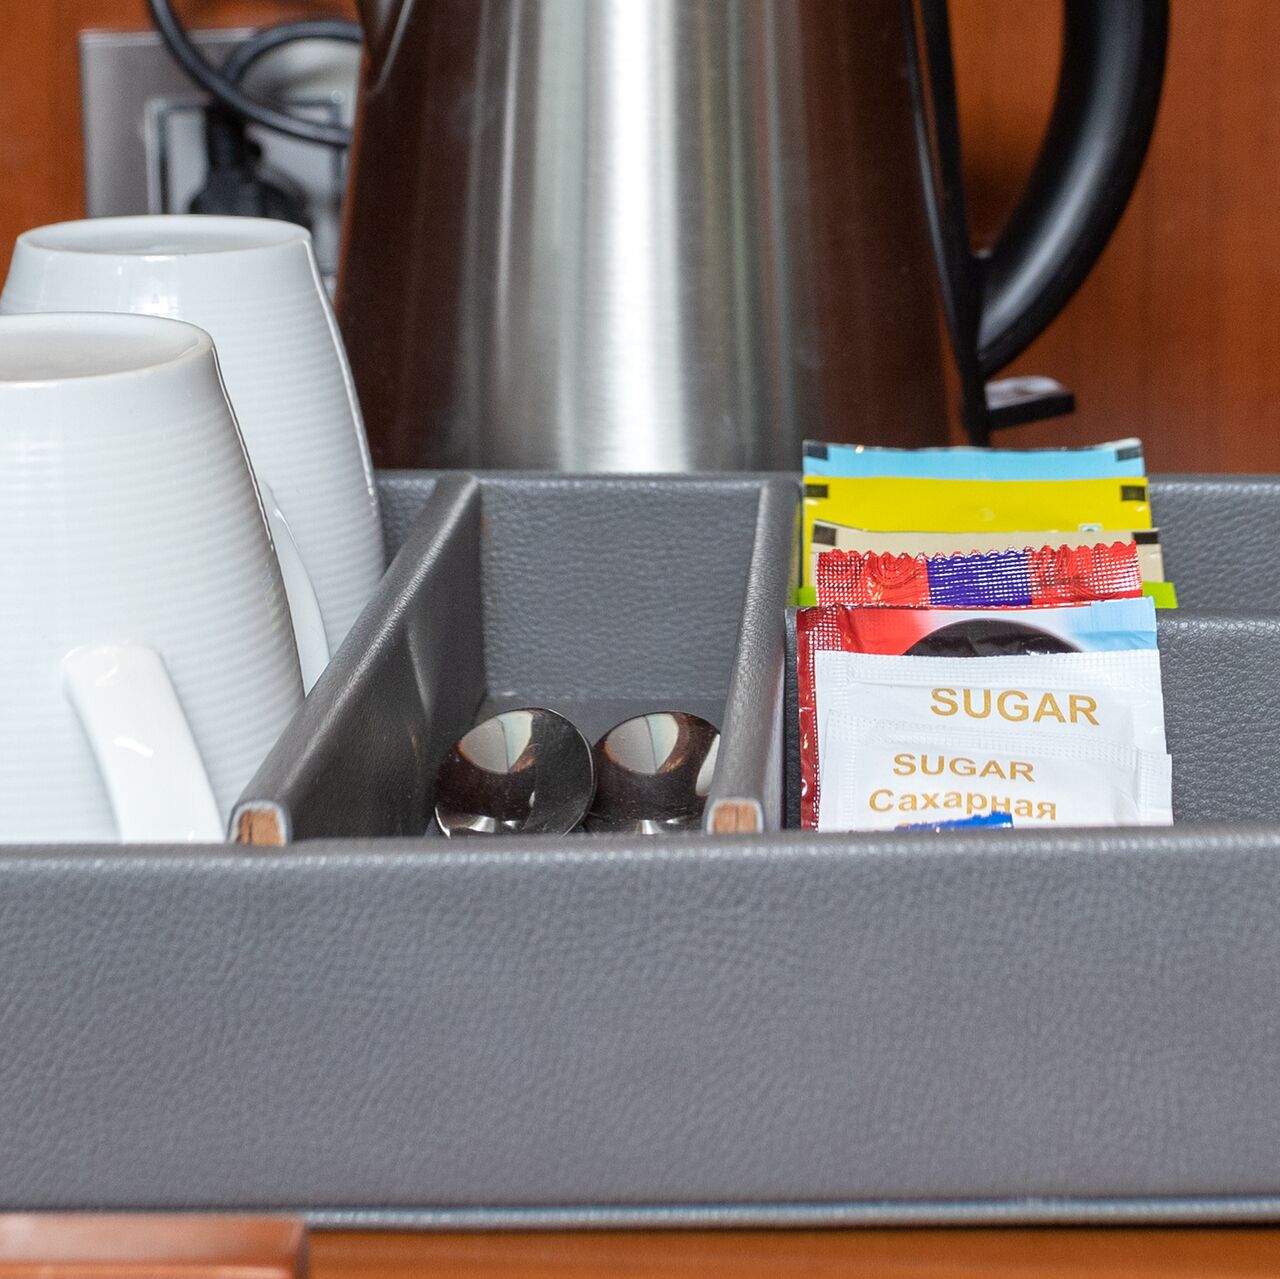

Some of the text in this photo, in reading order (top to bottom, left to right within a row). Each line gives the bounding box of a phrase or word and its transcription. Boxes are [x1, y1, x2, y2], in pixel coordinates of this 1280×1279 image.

[930, 688, 1100, 726] SUGAR
[893, 753, 1035, 783] SUGAR
[869, 788, 1057, 821] Сахарная
